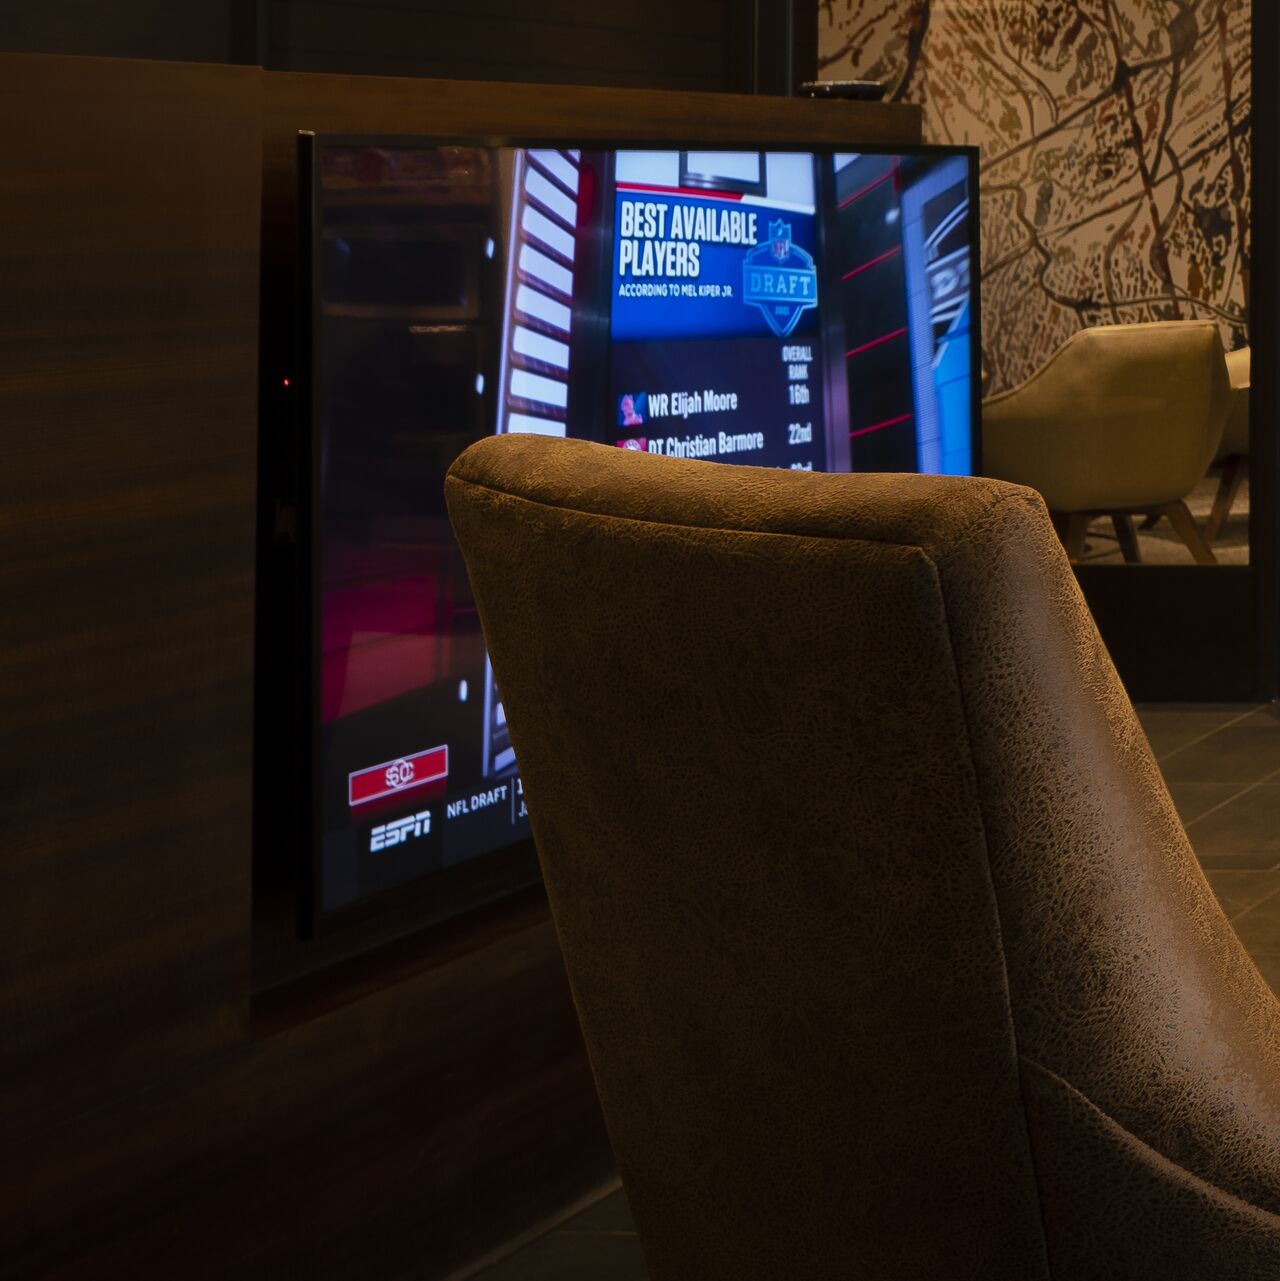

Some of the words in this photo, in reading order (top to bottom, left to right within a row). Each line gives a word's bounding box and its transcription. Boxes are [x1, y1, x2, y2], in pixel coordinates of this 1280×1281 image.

[620, 201, 668, 238] BEST
[670, 205, 757, 245] AVAILABLE
[619, 239, 700, 277] PLAYERS
[619, 283, 667, 297] ACCORDING
[669, 284, 680, 297] TO
[681, 284, 697, 297] MEL
[698, 285, 721, 297] KIPER
[750, 273, 811, 296] DRAFT
[782, 345, 813, 362] OVERALL
[788, 364, 809, 380] RANK
[648, 393, 668, 418] WR
[671, 391, 701, 418] Elijah
[703, 389, 738, 412] Moore
[788, 384, 810, 405] 16th
[666, 434, 716, 458] Christian
[718, 431, 764, 454] Barmore
[788, 423, 812, 444] 22nd
[446, 800, 469, 819] NFL
[470, 785, 507, 811] DRAFT
[370, 810, 431, 853] ESPN
